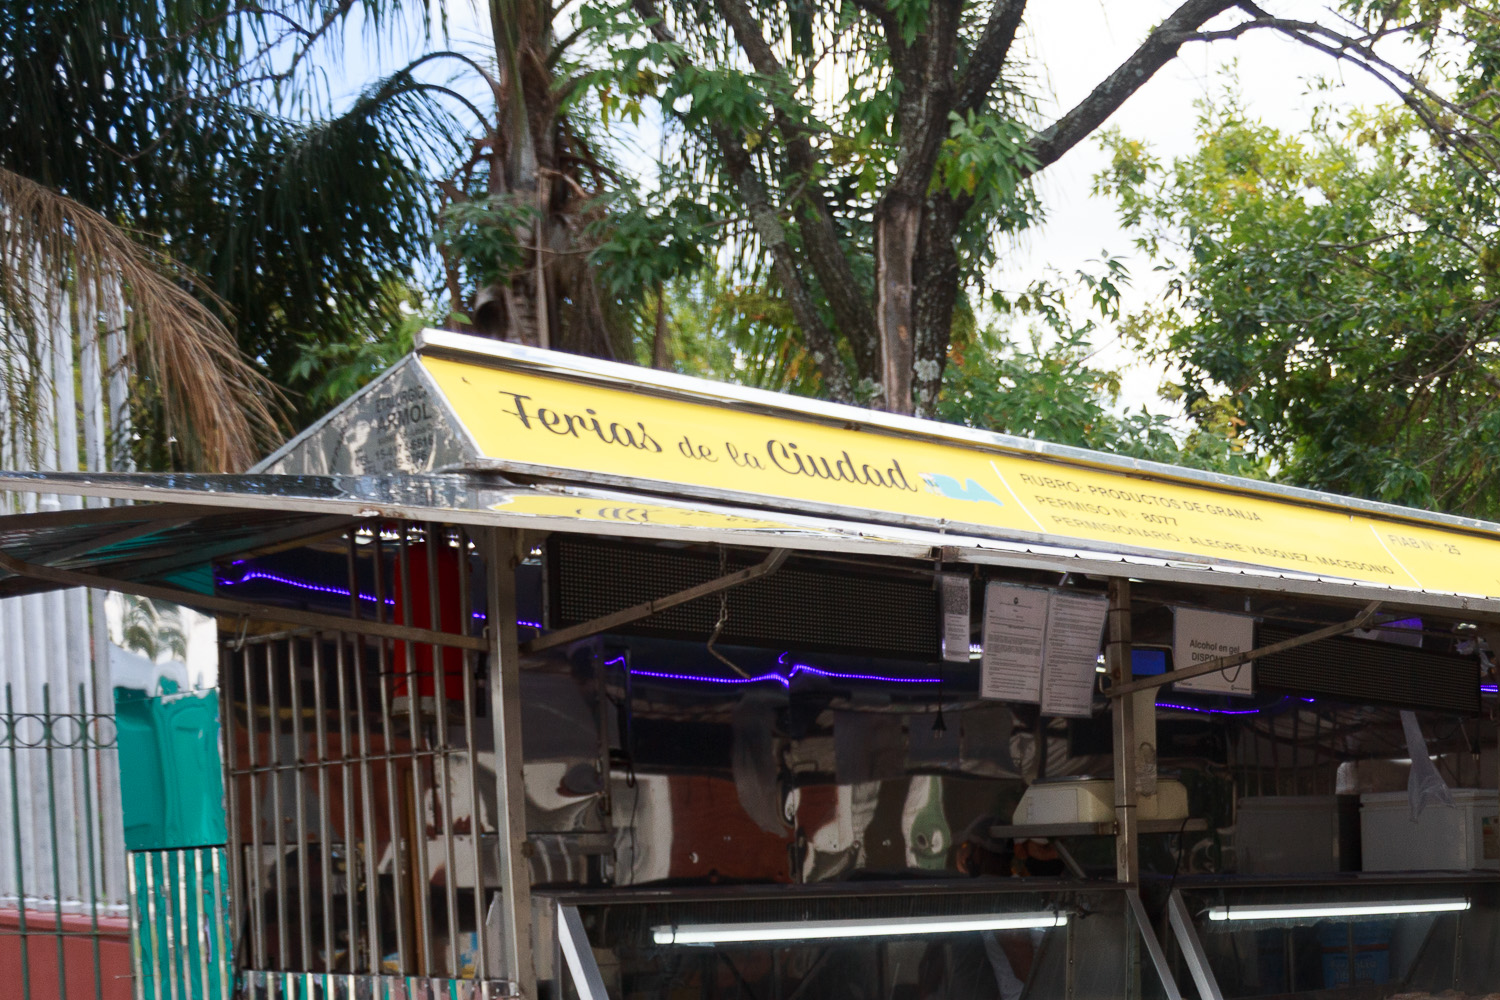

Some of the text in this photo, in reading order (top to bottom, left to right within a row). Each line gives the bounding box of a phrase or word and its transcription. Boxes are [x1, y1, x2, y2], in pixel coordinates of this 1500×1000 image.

[498, 389, 918, 494] Ferias de la Ciudad
[1019, 473, 1263, 523] RUBRO: PRODUCTOS DE GRANJA
[1034, 494, 1110, 516] PERMISO
[1141, 512, 1178, 526] 8077
[1188, 536, 1247, 553] ALEGRE
[1315, 555, 1394, 575] MACEDONIO
[1387, 534, 1420, 549] FIAB
[1444, 543, 1461, 555] 25
[1189, 640, 1217, 651] Alcohol
[1228, 646, 1240, 655] gel
